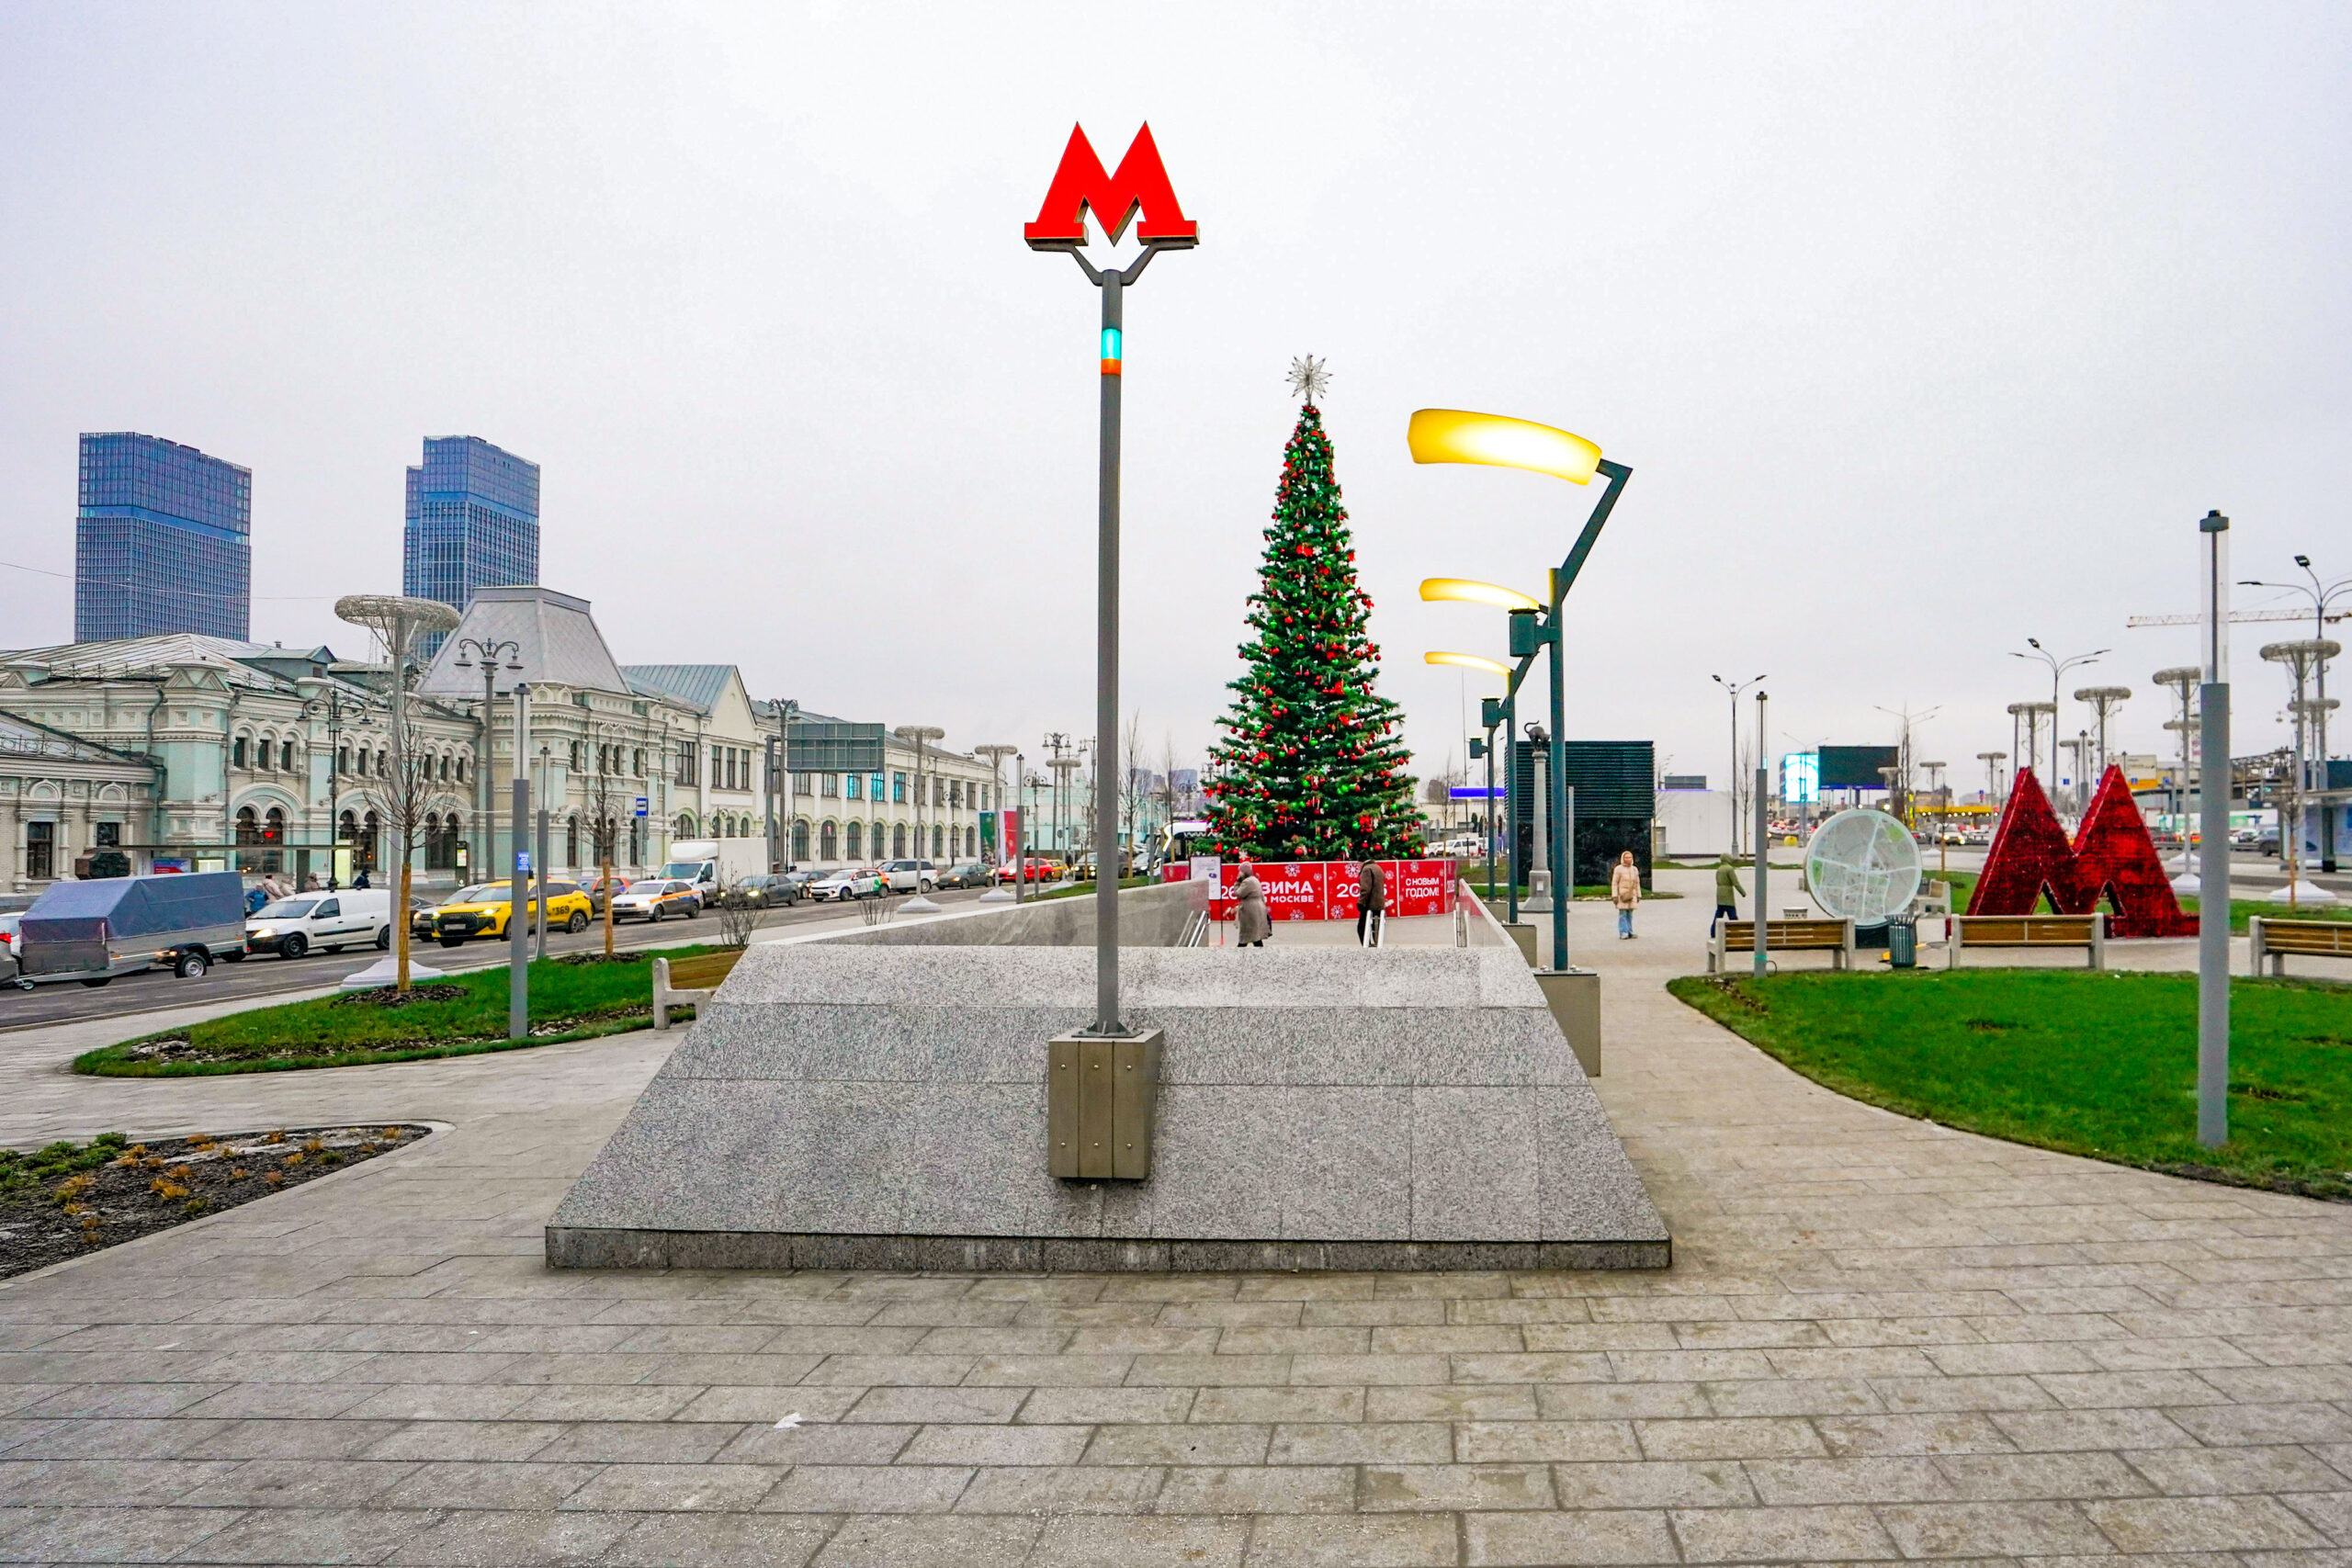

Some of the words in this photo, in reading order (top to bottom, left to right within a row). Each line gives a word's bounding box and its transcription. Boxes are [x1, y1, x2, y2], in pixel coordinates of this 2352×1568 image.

[1024, 120, 1199, 245] М
[1261, 881, 1314, 895] ЗИМА
[1405, 878, 1412, 886] С
[1412, 877, 1440, 886] НОВЫМ
[1271, 895, 1314, 903] МОСКВЕ
[1405, 886, 1440, 899] ГОДОМ!
